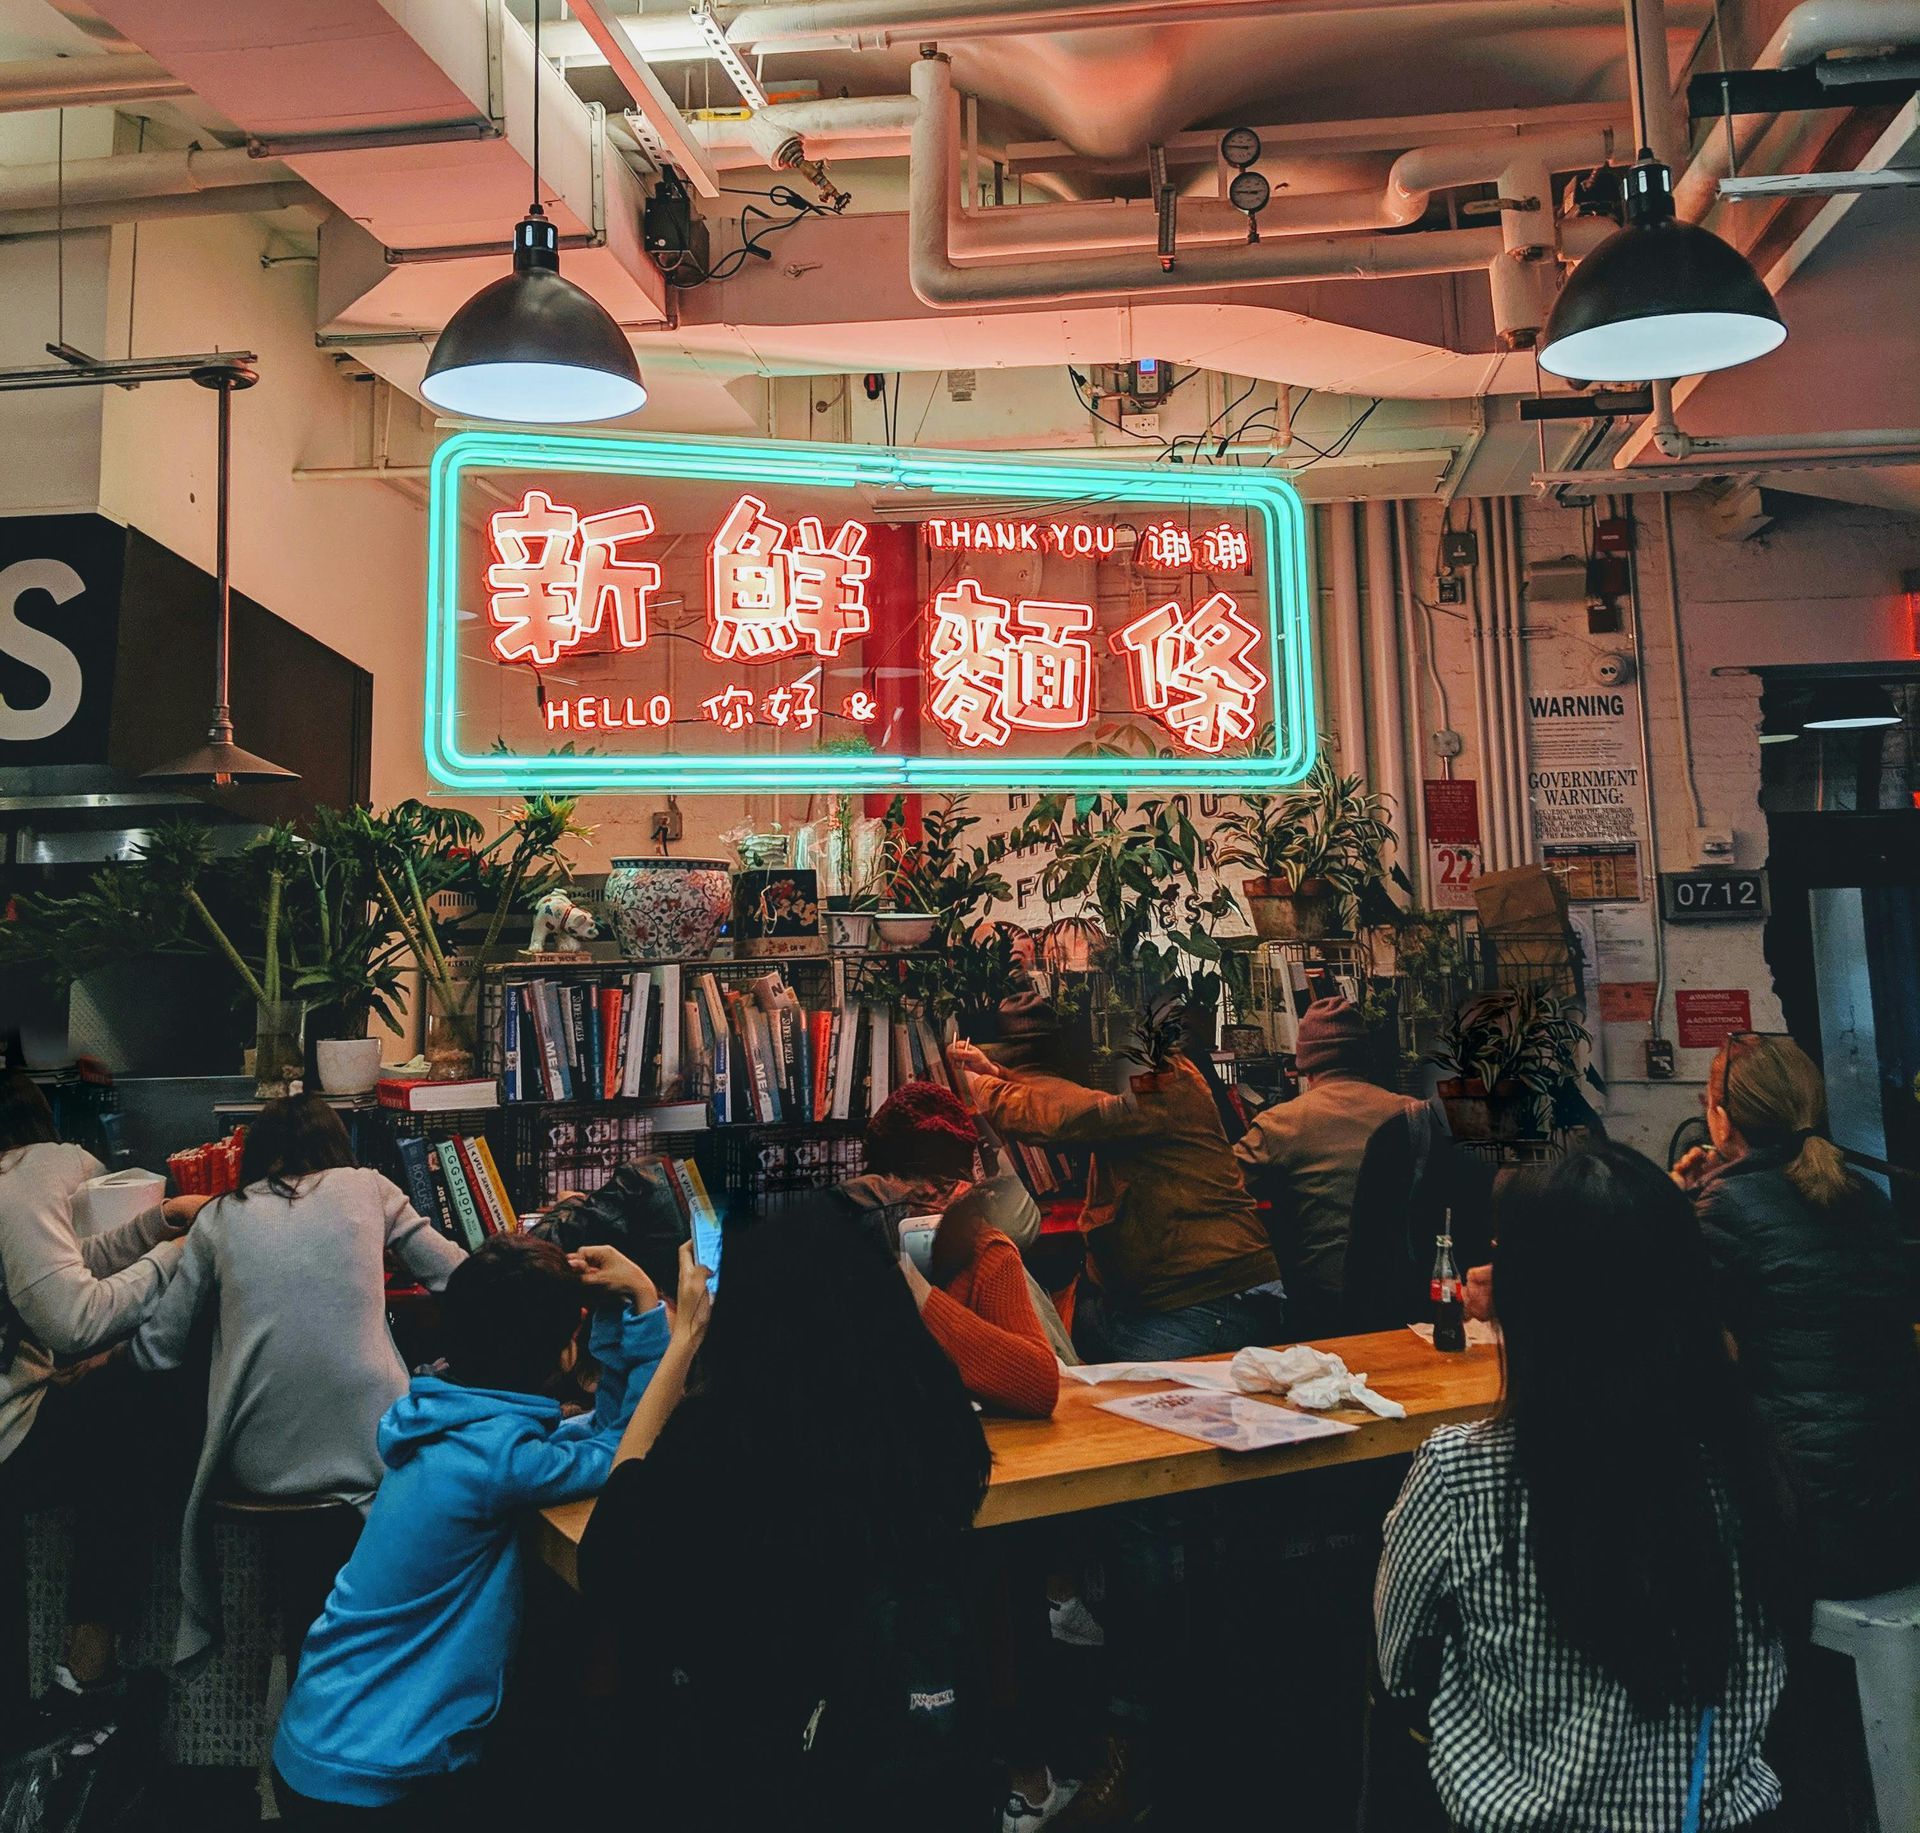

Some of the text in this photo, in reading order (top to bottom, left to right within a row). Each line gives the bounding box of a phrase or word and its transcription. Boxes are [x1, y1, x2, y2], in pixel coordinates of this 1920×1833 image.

[928, 519, 1249, 569] THANK YOU 谢谢
[487, 490, 871, 665] 新鮮
[546, 683, 877, 730] HELLO 你好 &
[1529, 695, 1624, 718] WARNING
[1528, 769, 1638, 789] GOVERNMENT
[1544, 787, 1624, 806] WARNING:
[412, 1163, 430, 1209] BOCUSE
[437, 1185, 446, 1203] JOE
